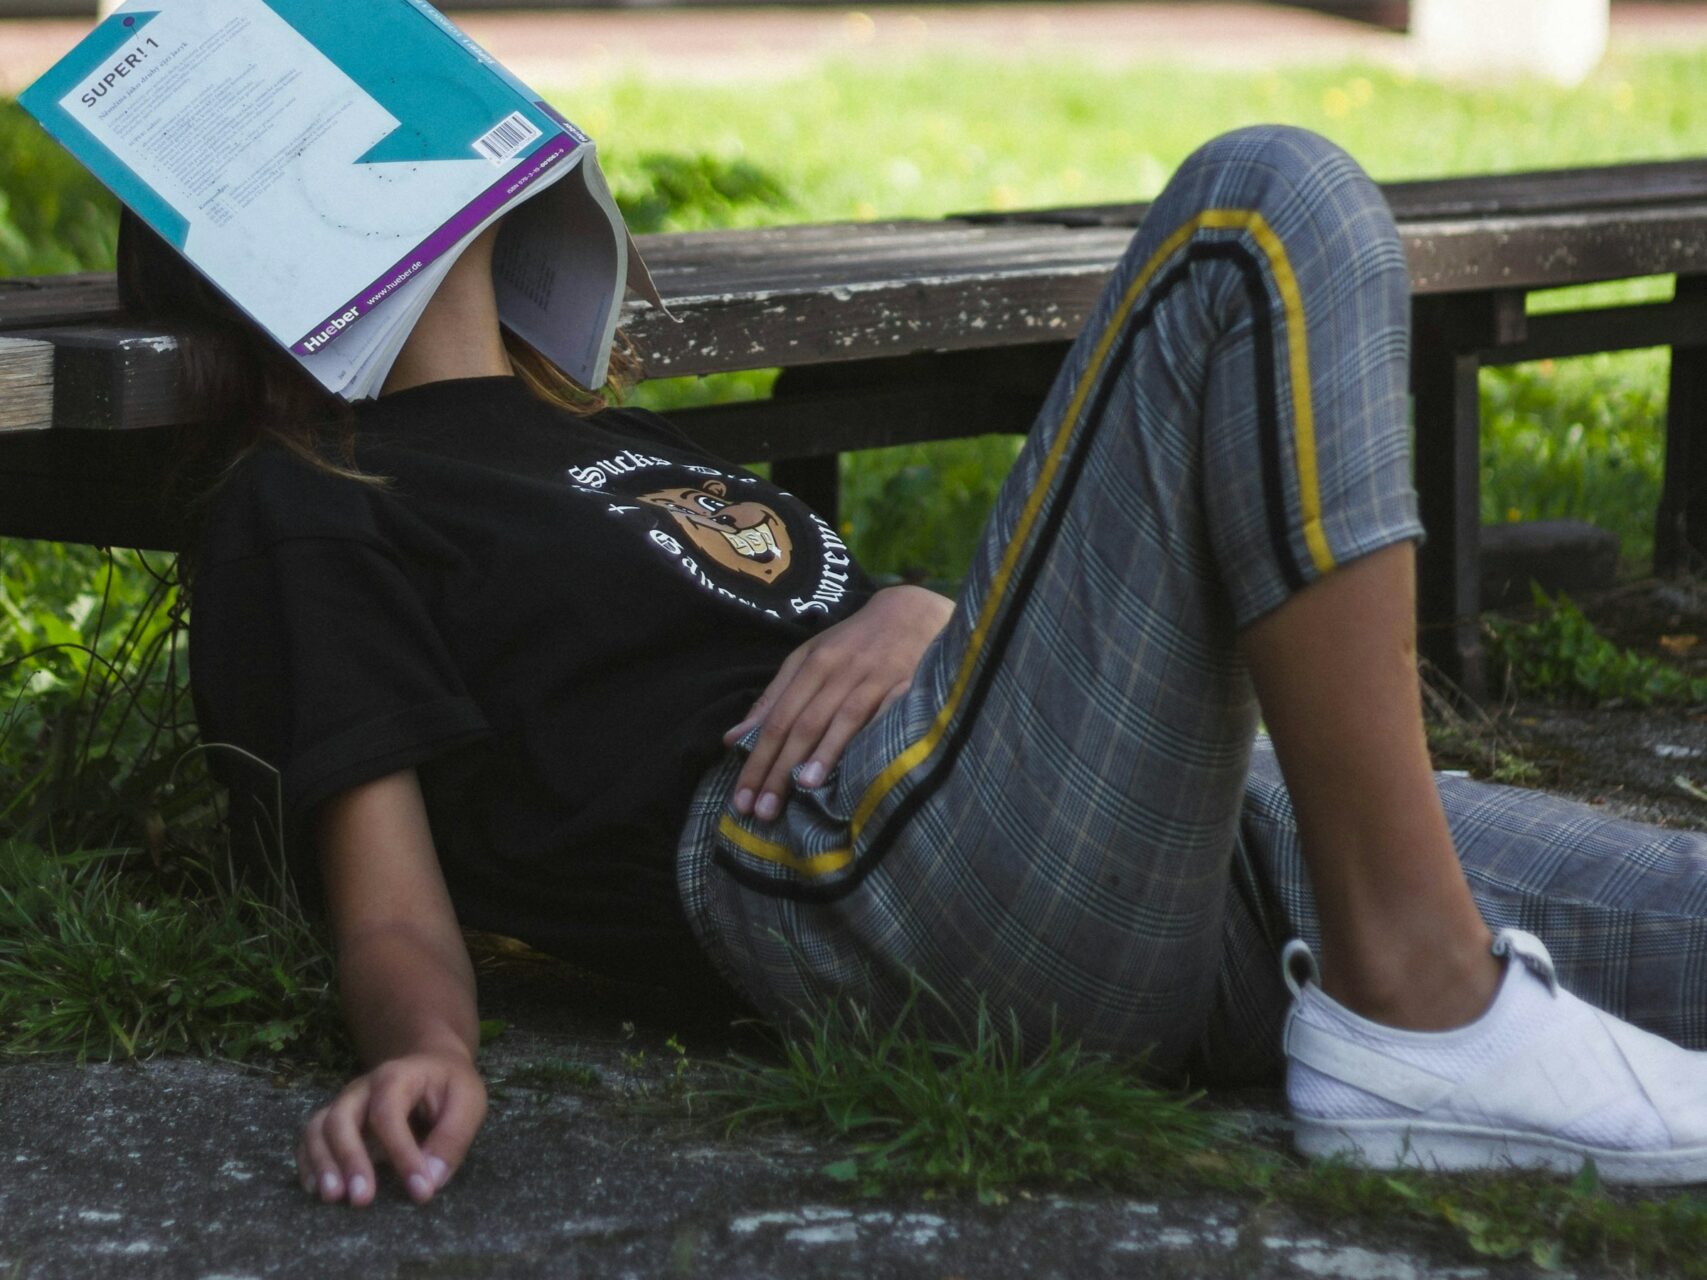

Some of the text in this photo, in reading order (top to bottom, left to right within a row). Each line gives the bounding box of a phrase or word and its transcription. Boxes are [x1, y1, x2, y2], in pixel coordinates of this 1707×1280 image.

[81, 37, 159, 108] SUPER! 1
[303, 305, 360, 352] Hueber
[366, 260, 423, 306] www.hueber.de
